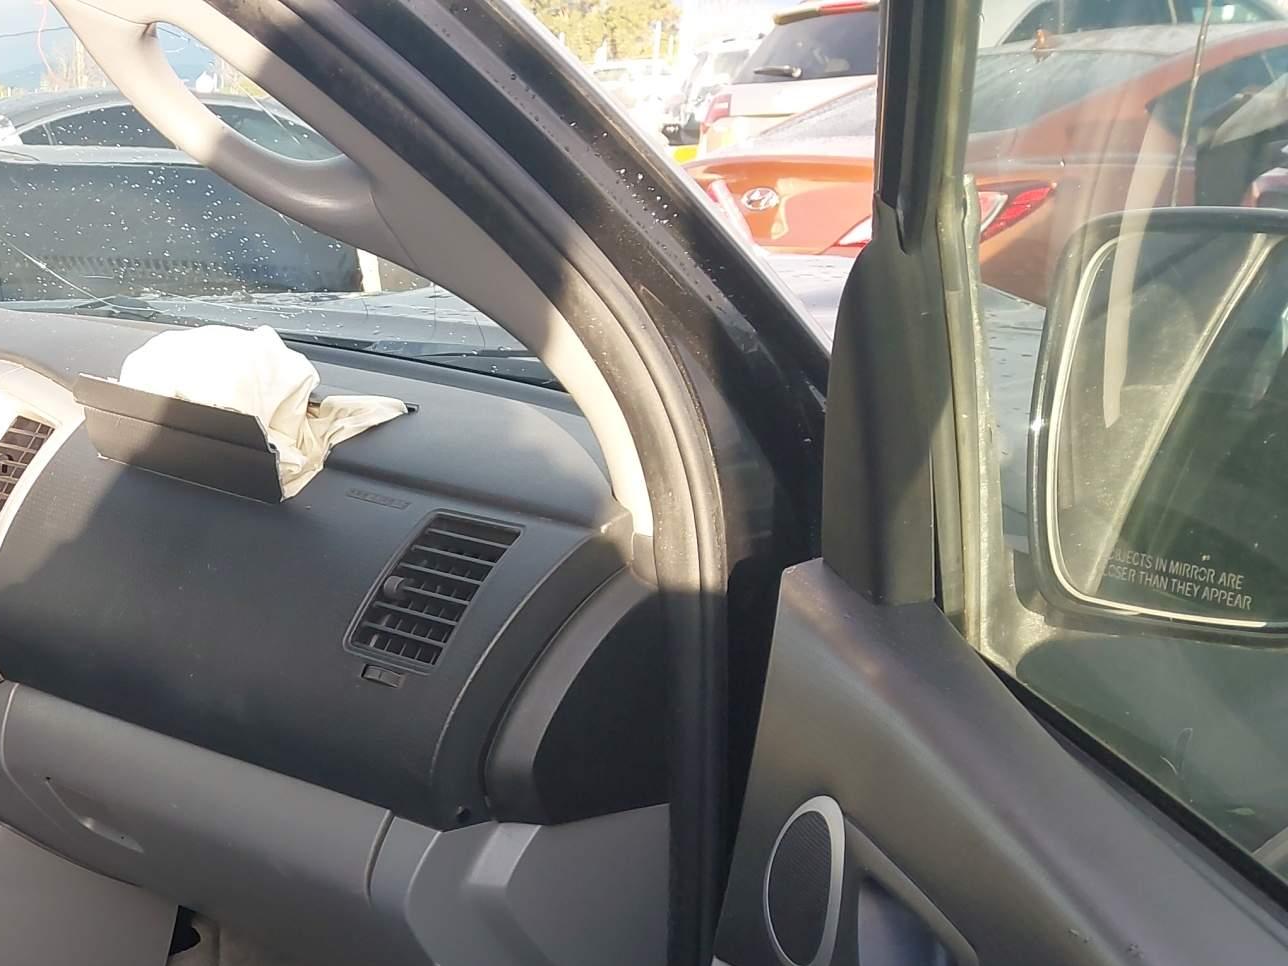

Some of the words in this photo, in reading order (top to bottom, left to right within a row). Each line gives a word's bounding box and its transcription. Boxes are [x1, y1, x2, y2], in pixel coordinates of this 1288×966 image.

[1139, 571, 1169, 591] THAN
[1171, 578, 1201, 598] THEY
[1201, 586, 1253, 611] APPEAR
[1155, 556, 1168, 573] IN
[1168, 559, 1216, 584] MIRROR
[1218, 571, 1245, 590] ARE
